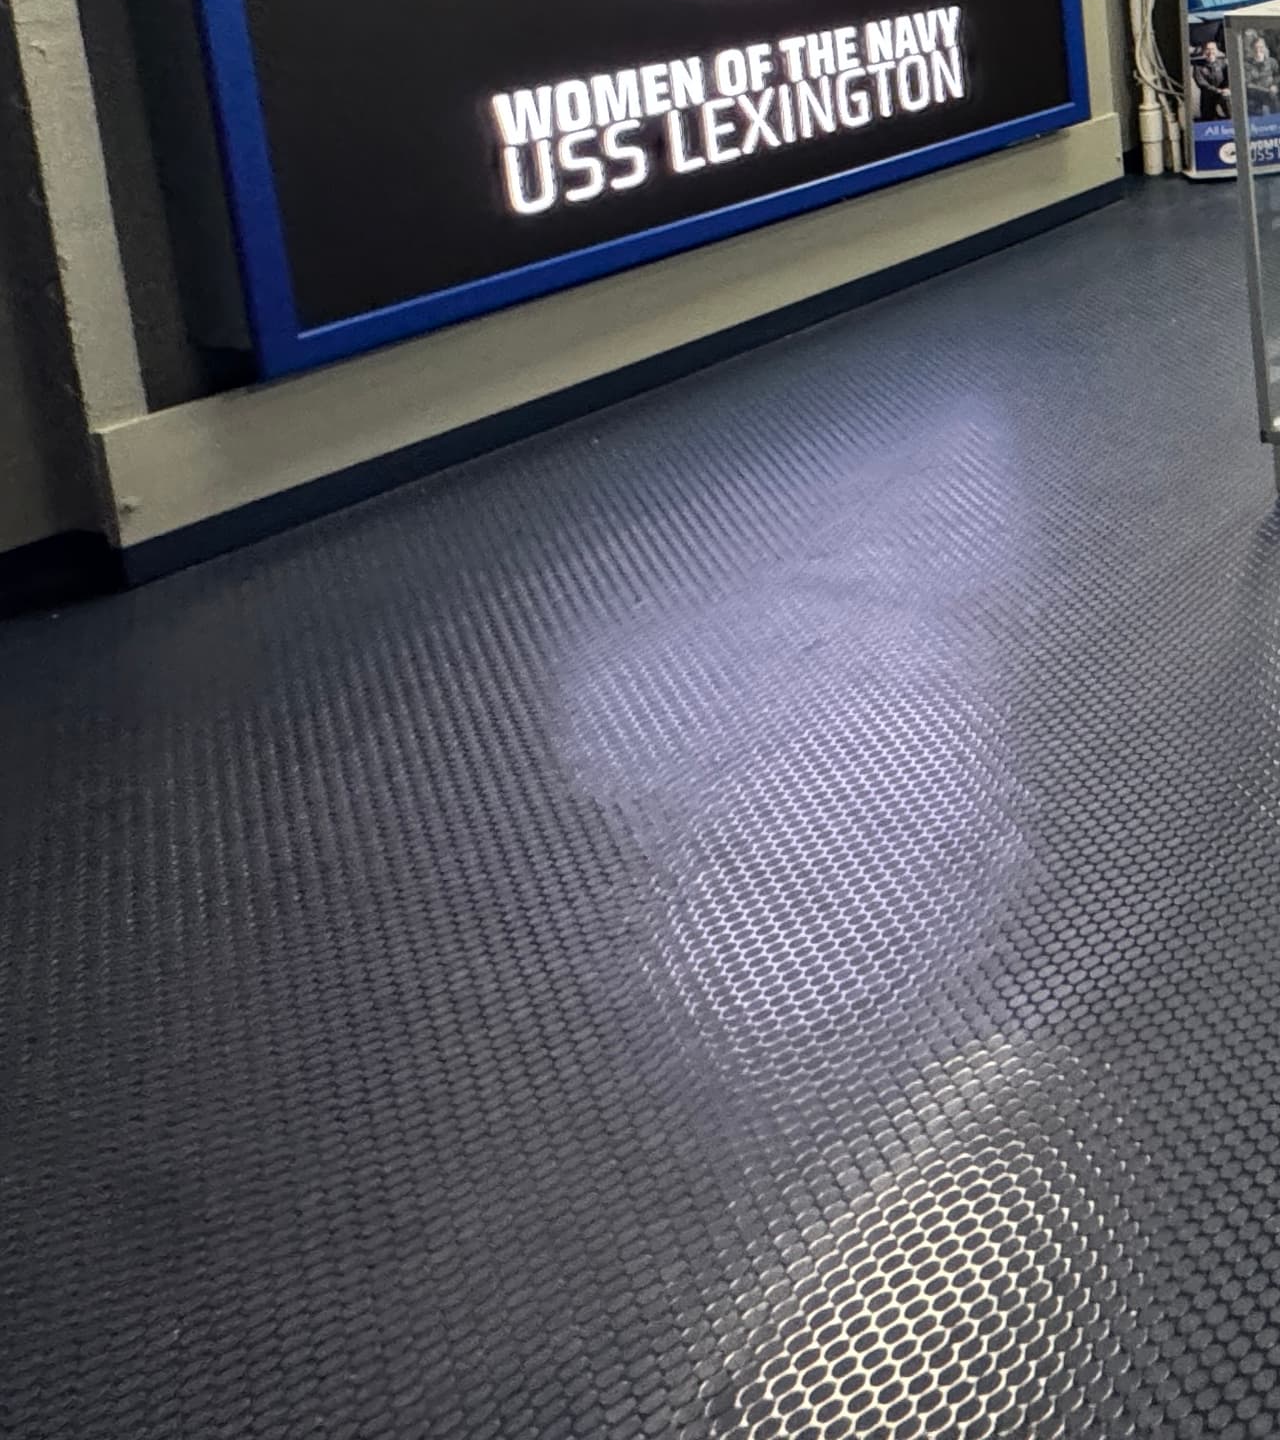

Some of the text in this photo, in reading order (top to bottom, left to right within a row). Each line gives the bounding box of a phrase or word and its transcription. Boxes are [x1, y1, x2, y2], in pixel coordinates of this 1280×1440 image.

[492, 6, 962, 147] WOMEN OF THE NAVY
[503, 46, 966, 215] USS LEXINGTON
